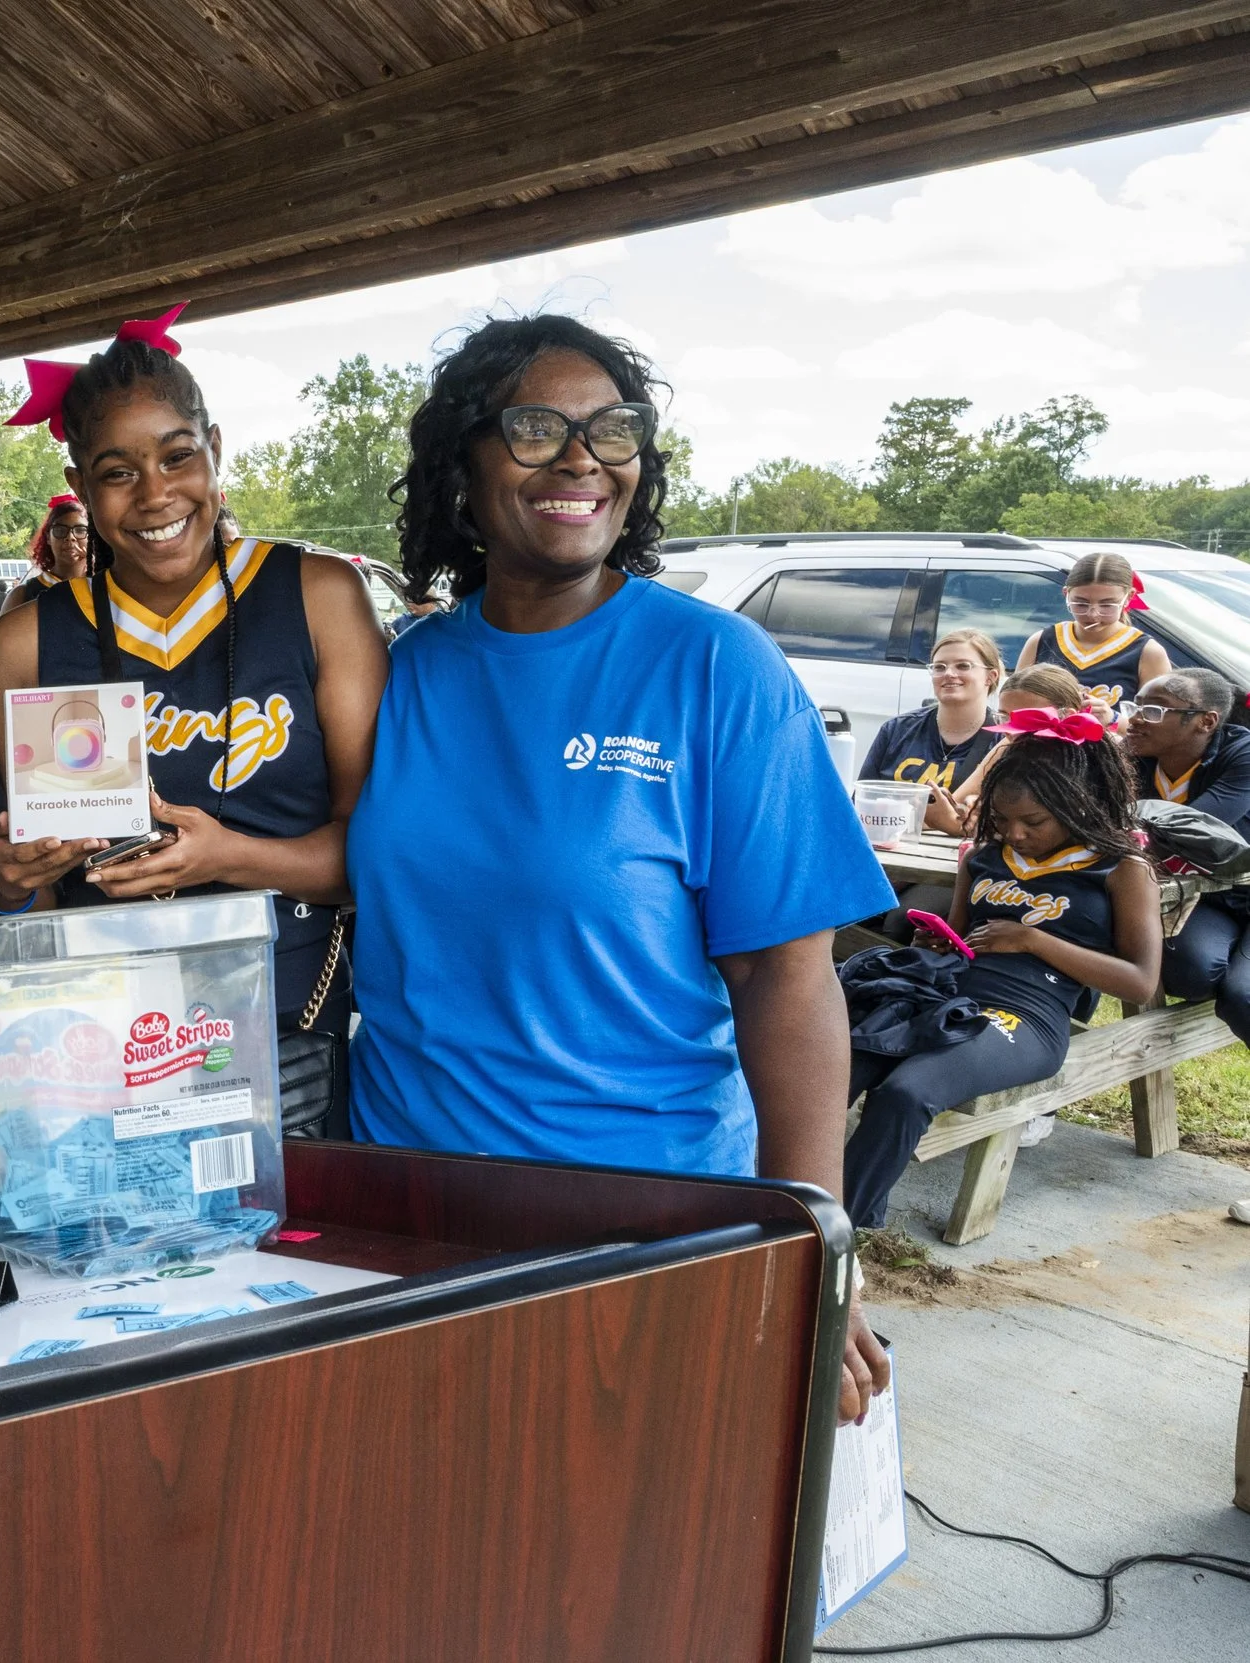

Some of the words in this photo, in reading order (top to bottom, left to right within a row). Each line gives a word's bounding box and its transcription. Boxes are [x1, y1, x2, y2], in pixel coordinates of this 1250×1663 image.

[603, 735, 661, 754] ROANOKE
[599, 749, 675, 773] COOPERATIVE
[26, 799, 78, 811] Karaoke
[80, 796, 133, 808] Machine
[971, 878, 1070, 926] Vikings
[124, 1036, 175, 1065] Sweet
[176, 1021, 231, 1050] Stripes
[130, 1074, 147, 1083] SOFT
[148, 1061, 184, 1080] Peppermint
[184, 1054, 205, 1066] Candy
[113, 1107, 141, 1116] Nutrition
[143, 1104, 160, 1112] Facts
[90, 1277, 161, 1292] NC
